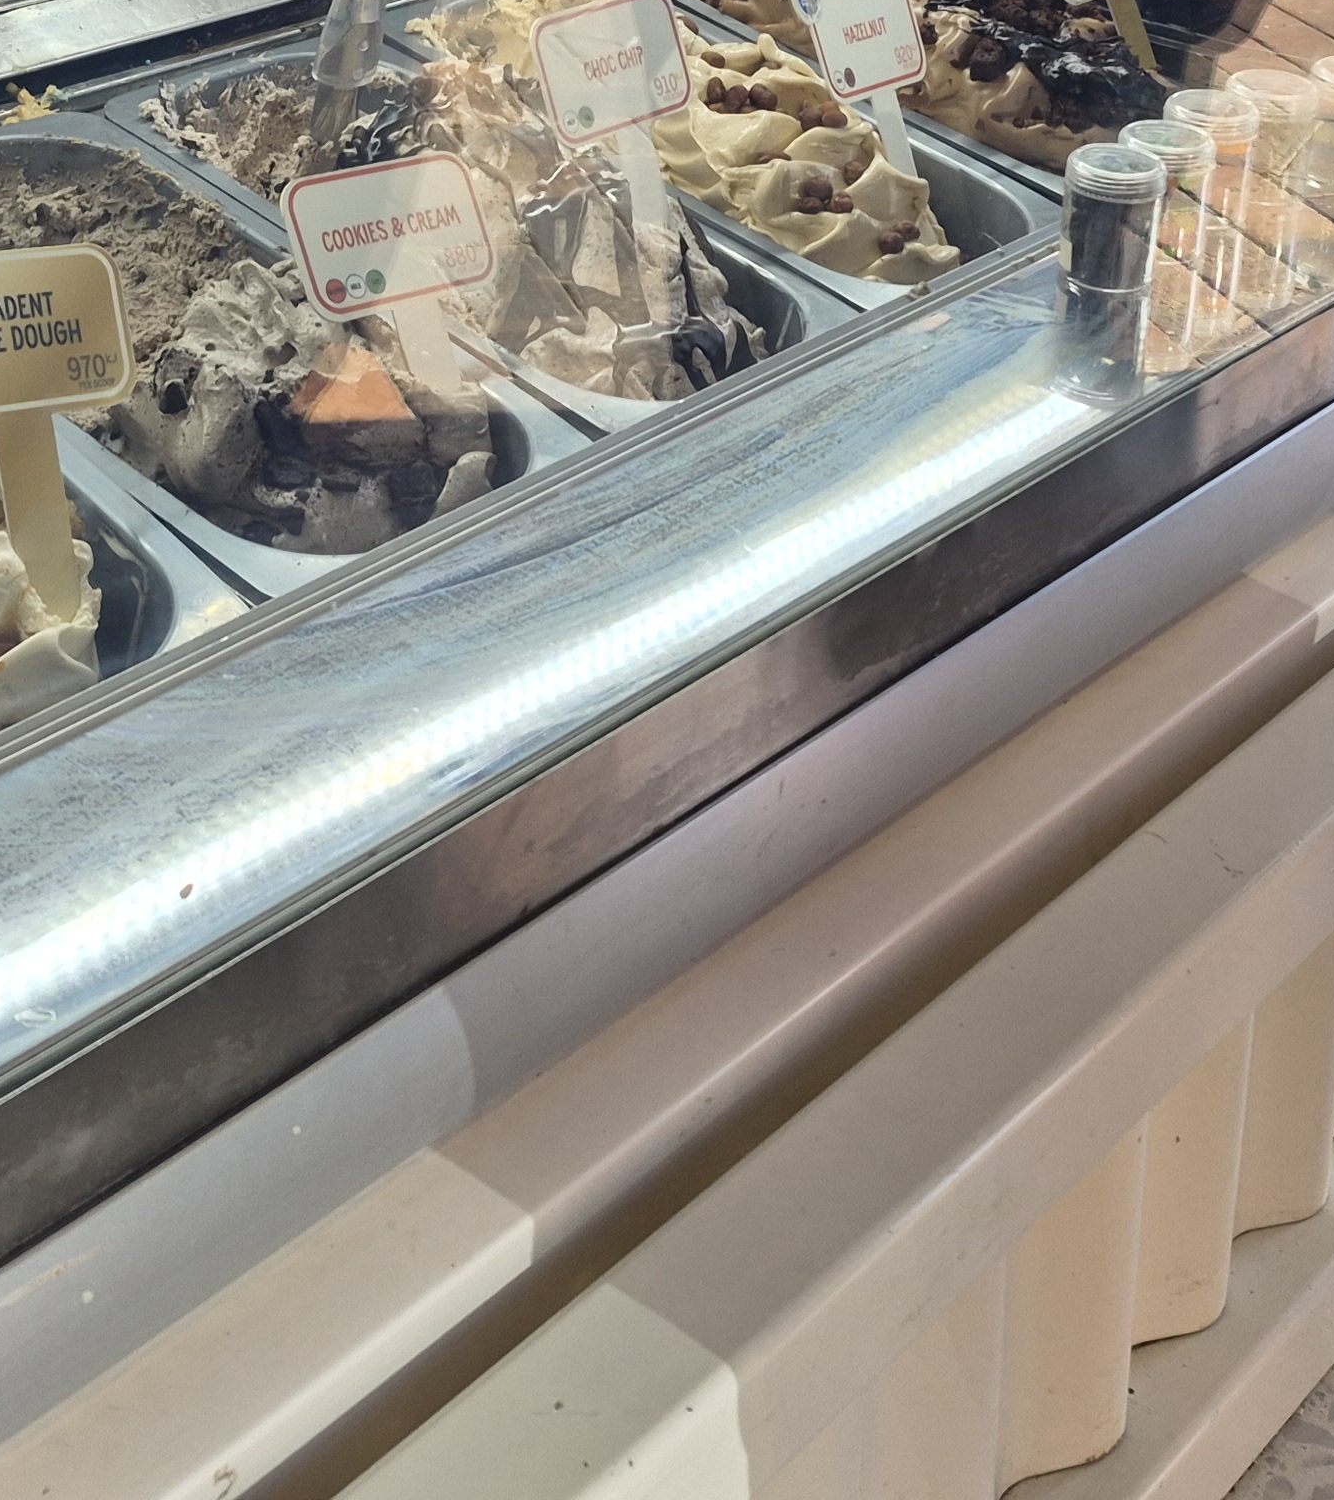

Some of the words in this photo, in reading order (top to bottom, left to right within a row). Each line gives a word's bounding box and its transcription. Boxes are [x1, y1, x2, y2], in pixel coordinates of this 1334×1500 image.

[842, 16, 887, 45] HAZELNUT
[583, 54, 617, 81] CHOC
[617, 45, 644, 71] CHIP
[321, 219, 389, 252] COOKIES
[391, 217, 406, 238] &
[406, 204, 462, 234] CREAM
[10, 318, 82, 351] DOUGH
